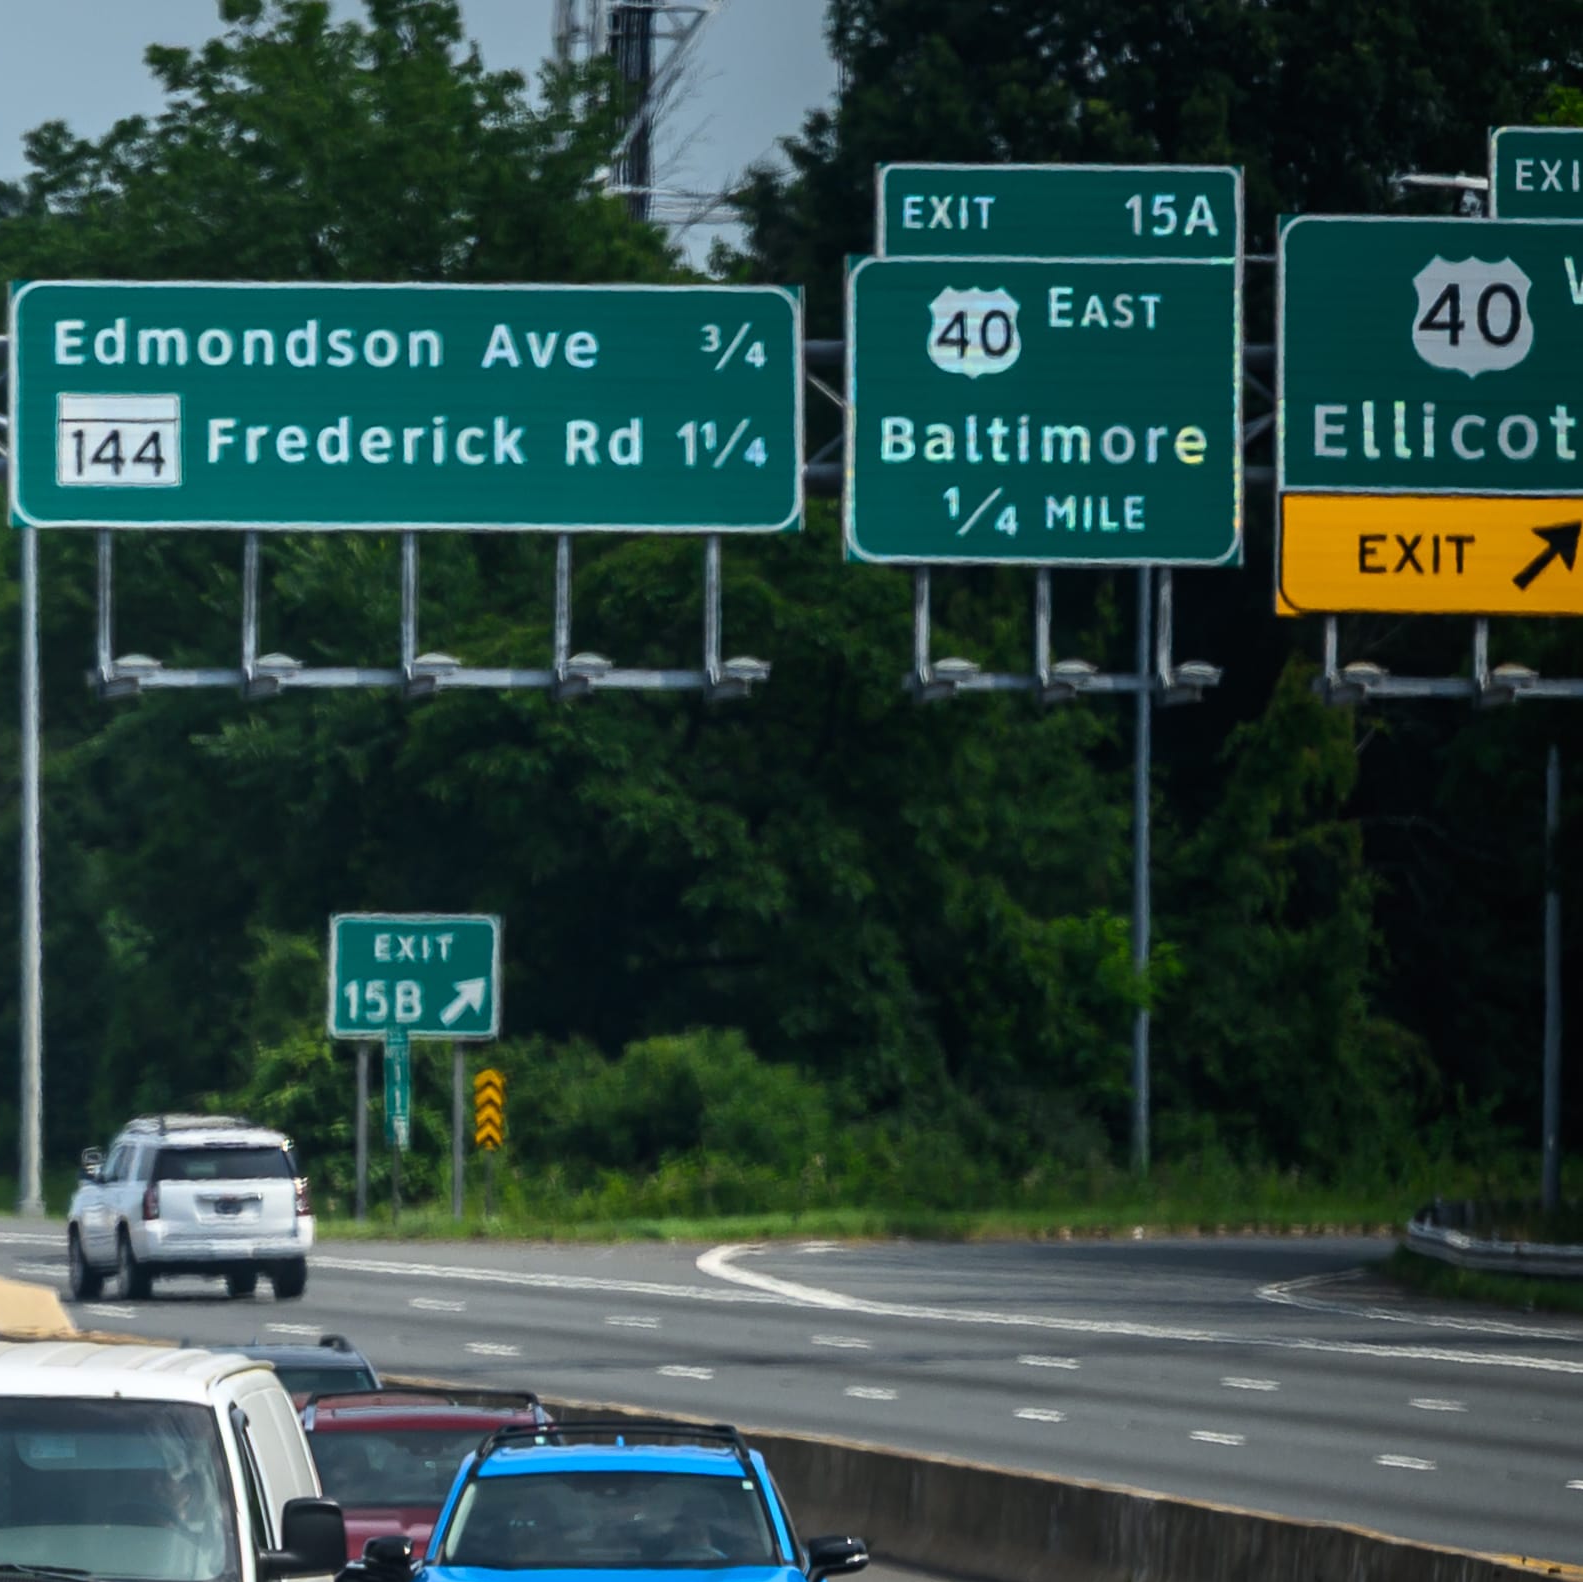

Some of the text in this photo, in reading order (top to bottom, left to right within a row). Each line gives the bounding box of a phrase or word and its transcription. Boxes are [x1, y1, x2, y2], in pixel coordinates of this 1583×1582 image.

[902, 194, 1220, 236] EXIT 15A
[1048, 287, 1161, 329] EAST
[1417, 281, 1522, 348] 40
[53, 316, 443, 368] Edmondson
[481, 323, 600, 369] Ave
[935, 309, 1014, 359] 40
[71, 428, 166, 478] 144
[206, 415, 524, 466] Frederick
[565, 416, 643, 466] Rd
[880, 415, 1208, 464] Baltimore
[1313, 401, 1577, 460] Ellicot
[1045, 495, 1146, 532] MILE
[1357, 534, 1477, 576] EXIT
[374, 933, 455, 962] EXIT
[343, 979, 423, 1024] 15B
